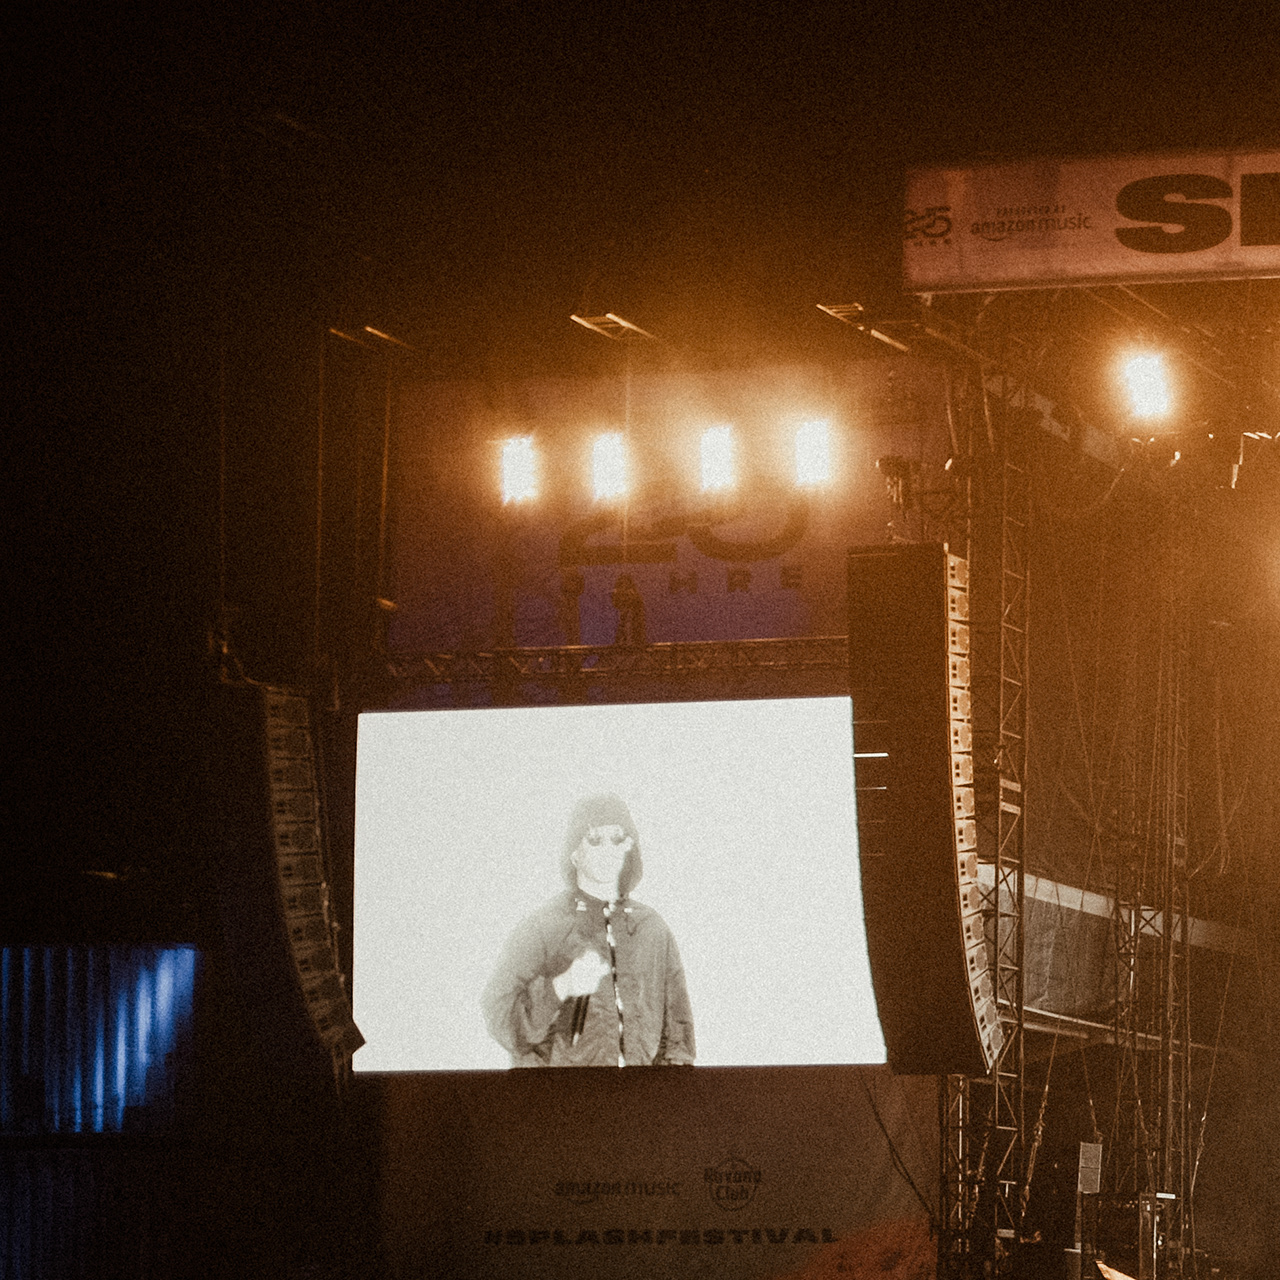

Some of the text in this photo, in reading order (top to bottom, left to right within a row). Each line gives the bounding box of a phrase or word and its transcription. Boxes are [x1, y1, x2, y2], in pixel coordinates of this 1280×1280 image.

[970, 212, 1094, 236] amazon music
[715, 1184, 750, 1202] Club
[484, 1227, 840, 1246] #SPLASHFESTIVAL
